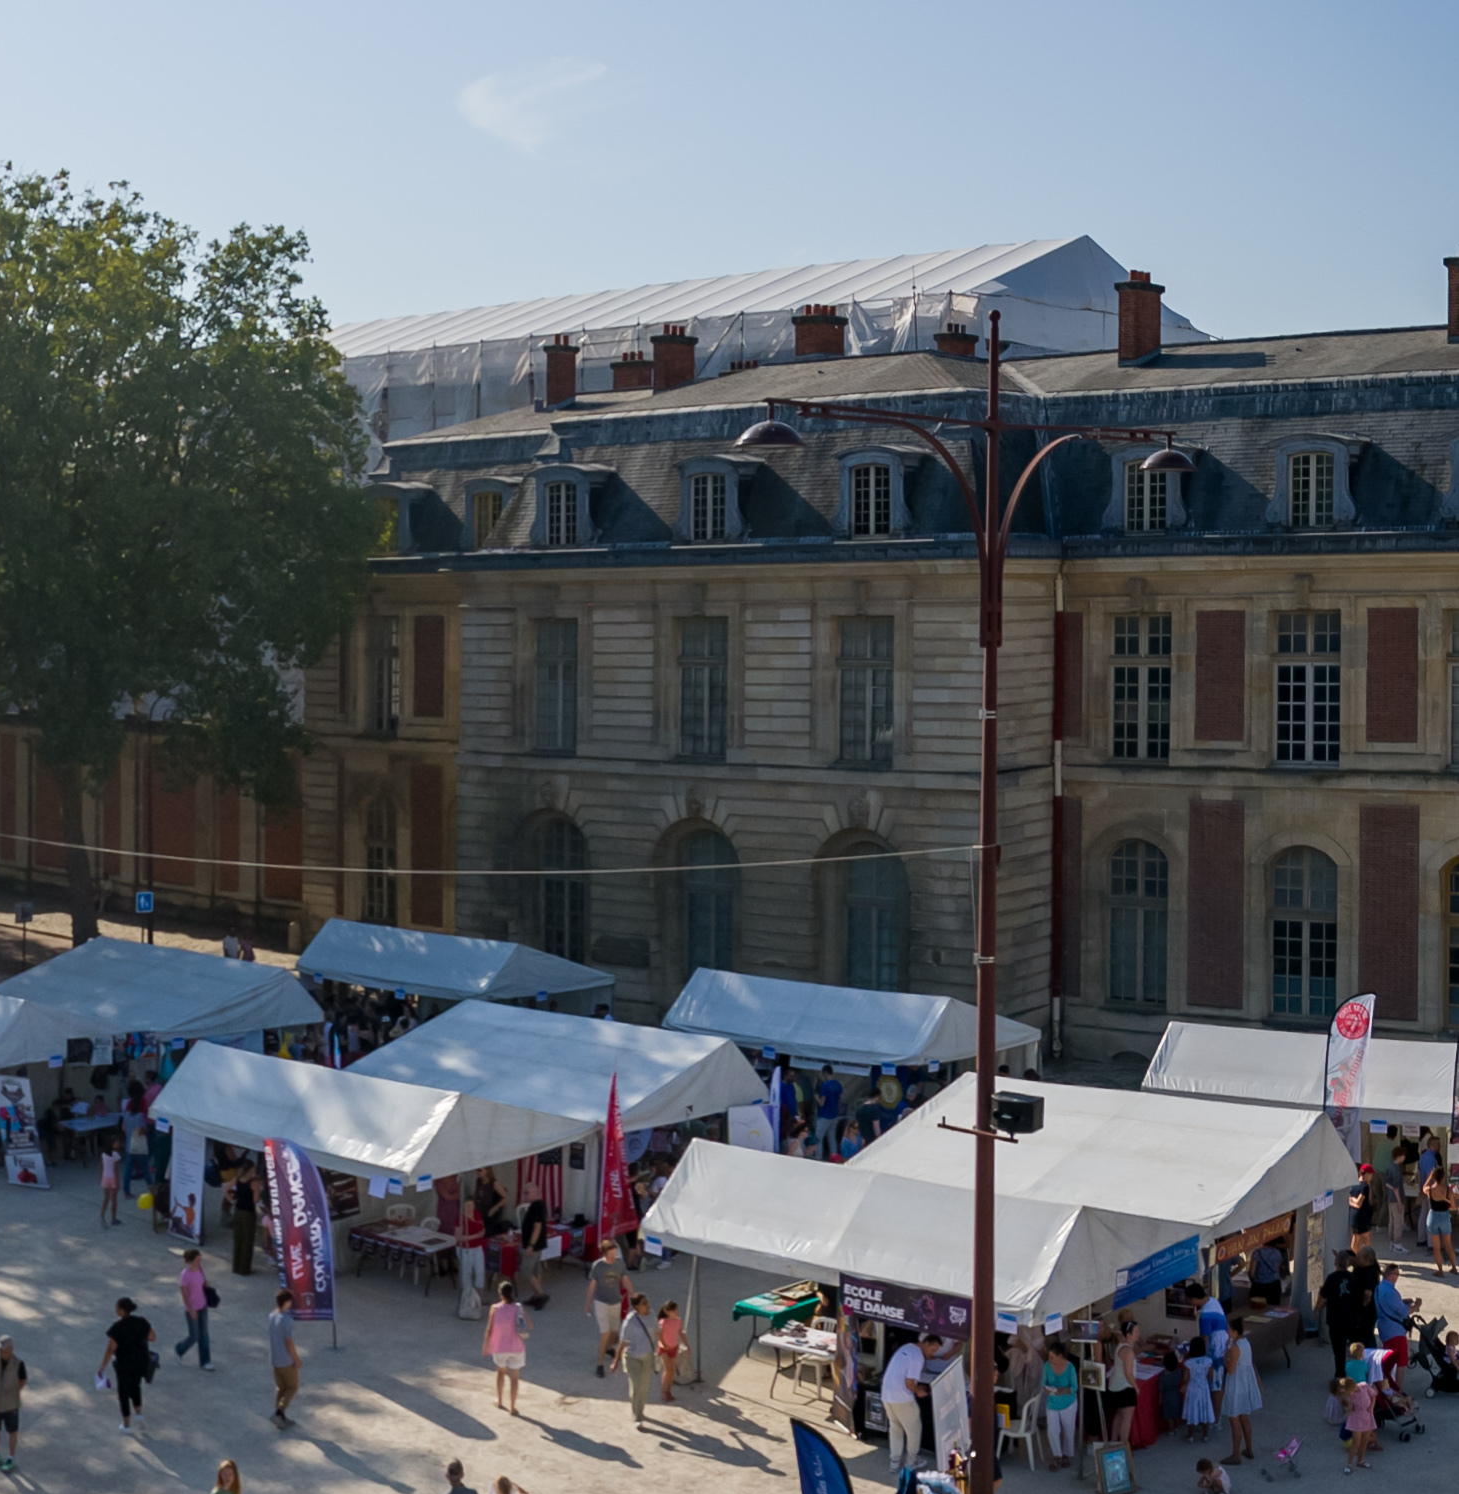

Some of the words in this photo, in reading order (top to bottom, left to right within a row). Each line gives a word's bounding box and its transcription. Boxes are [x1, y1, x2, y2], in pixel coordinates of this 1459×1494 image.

[844, 1283, 882, 1302] ECOLE
[844, 1296, 862, 1310] DE
[863, 1301, 905, 1320] DANSE
